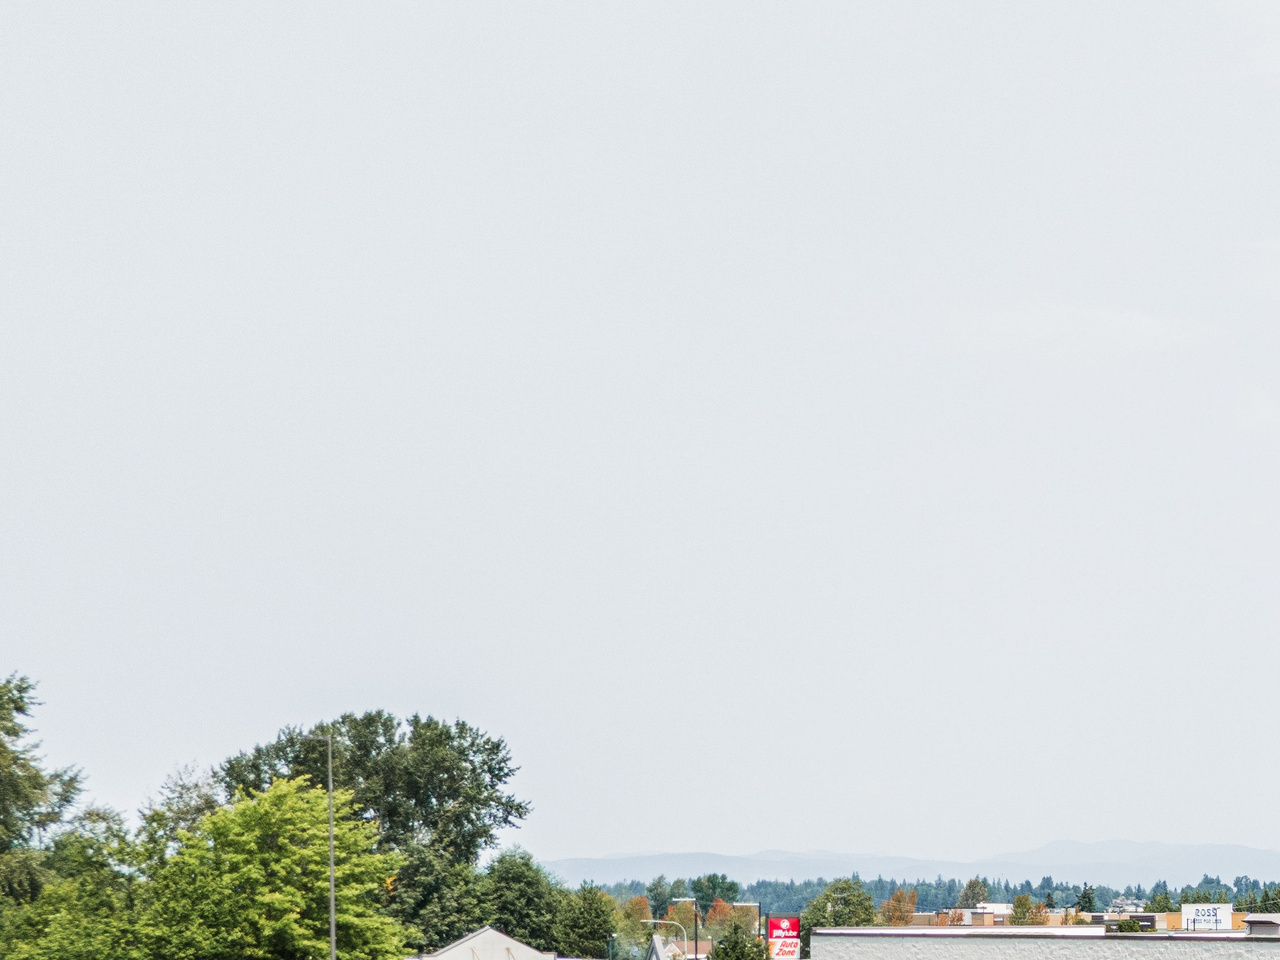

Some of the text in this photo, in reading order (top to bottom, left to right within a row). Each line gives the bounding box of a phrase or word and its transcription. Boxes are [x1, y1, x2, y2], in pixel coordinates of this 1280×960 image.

[1195, 907, 1217, 917] ROSS
[780, 940, 799, 948] Auto
[775, 948, 796, 956] Zone
